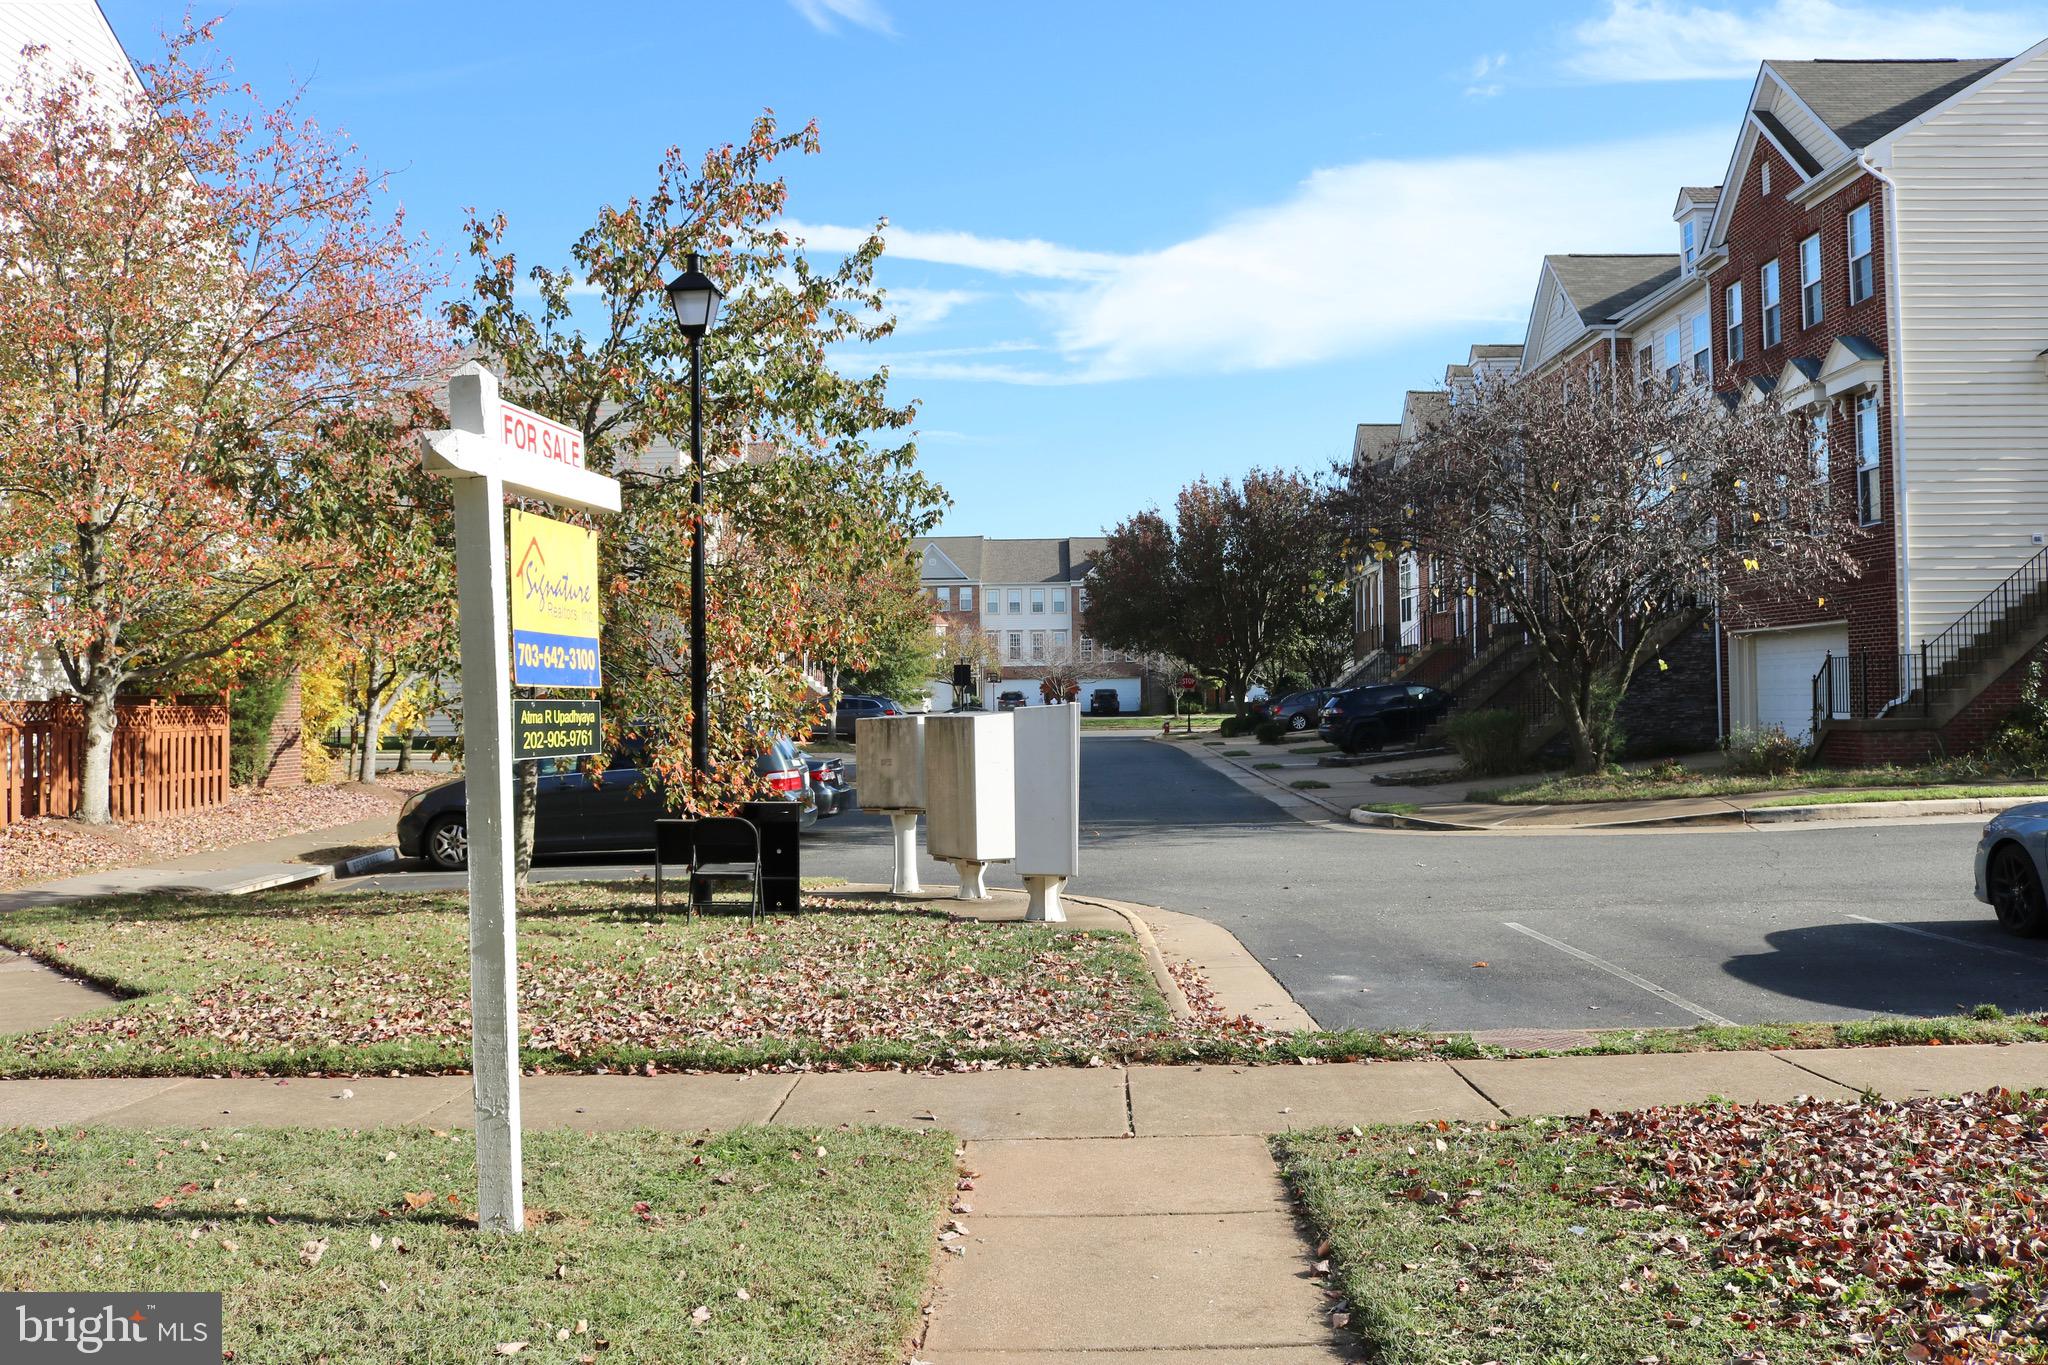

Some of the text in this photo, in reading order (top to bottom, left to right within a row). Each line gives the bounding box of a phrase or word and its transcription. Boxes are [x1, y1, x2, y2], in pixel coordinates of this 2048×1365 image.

[504, 414, 581, 468] FOR SALE
[526, 560, 591, 612] Signature
[518, 643, 595, 671] 703-642-3100
[1182, 677, 1195, 685] STOP
[520, 709, 596, 727] Atma R Upadhyaya
[523, 729, 593, 750] 202-905-9761
